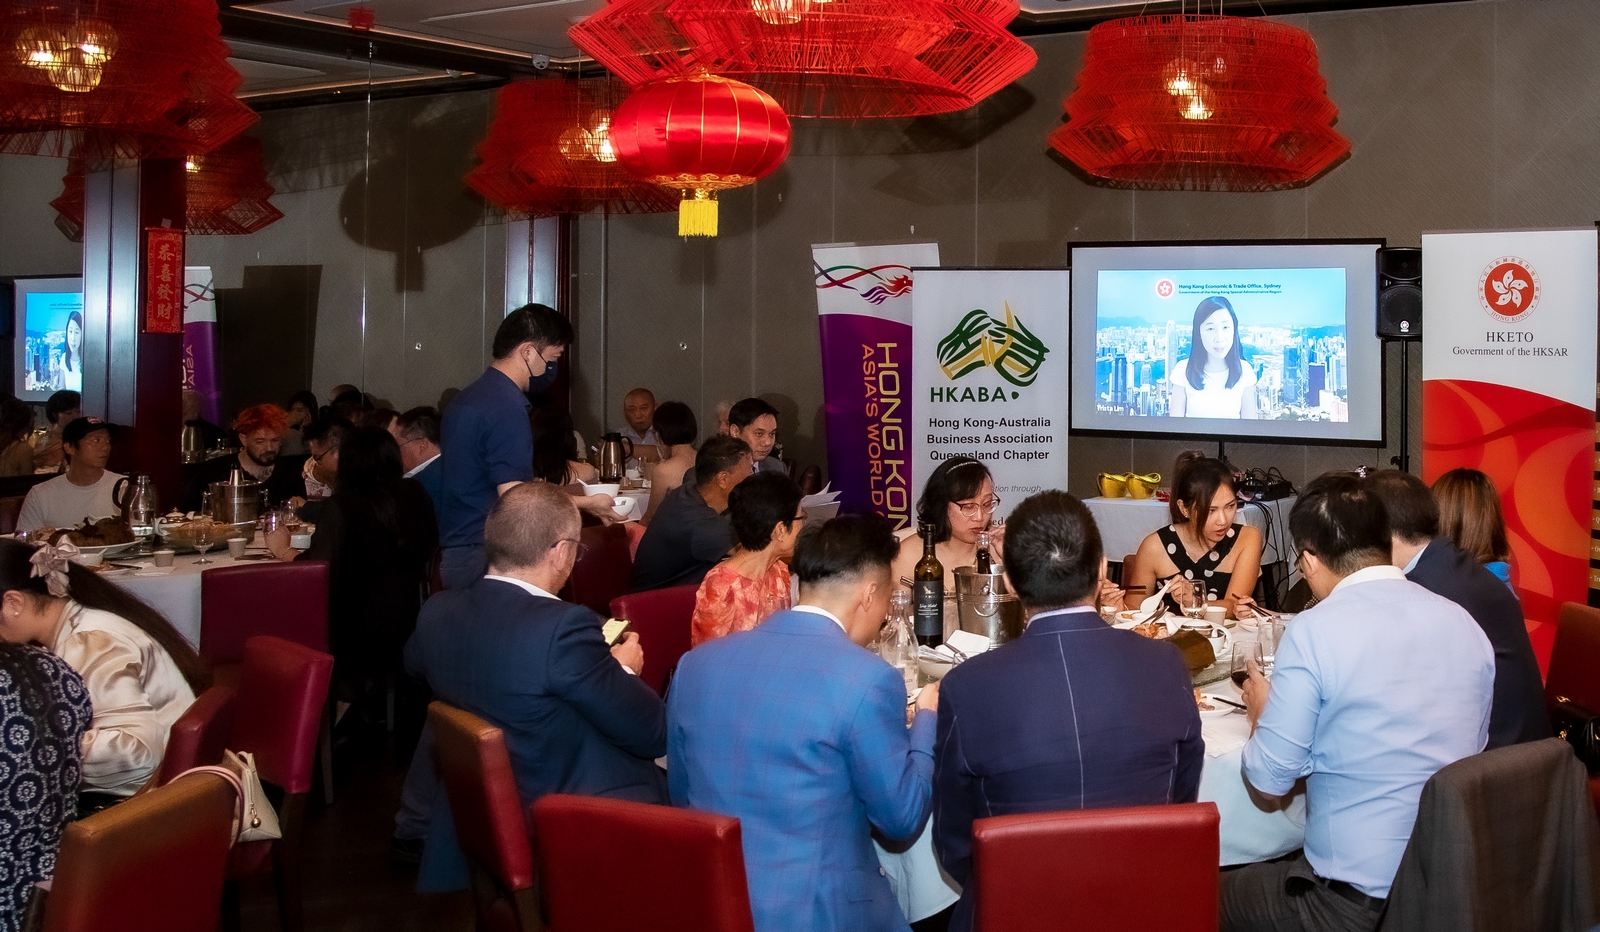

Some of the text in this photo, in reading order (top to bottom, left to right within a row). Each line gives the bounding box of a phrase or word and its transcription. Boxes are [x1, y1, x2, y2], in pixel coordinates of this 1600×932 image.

[156, 243, 175, 319] 恭喜發財
[1491, 311, 1529, 322] HONG KONG
[1486, 332, 1534, 342] HKETO
[1452, 346, 1568, 356] Government of the HKSAR
[862, 343, 879, 417] ASIA'S
[930, 387, 1007, 402] HKABA
[929, 417, 1051, 430] Hong Kong-Australia
[877, 343, 909, 532] HONG KON
[927, 434, 1053, 444] Business Association
[1003, 450, 1050, 462] Chapter
[867, 423, 884, 506] WORLD
[1011, 485, 1041, 493] through
